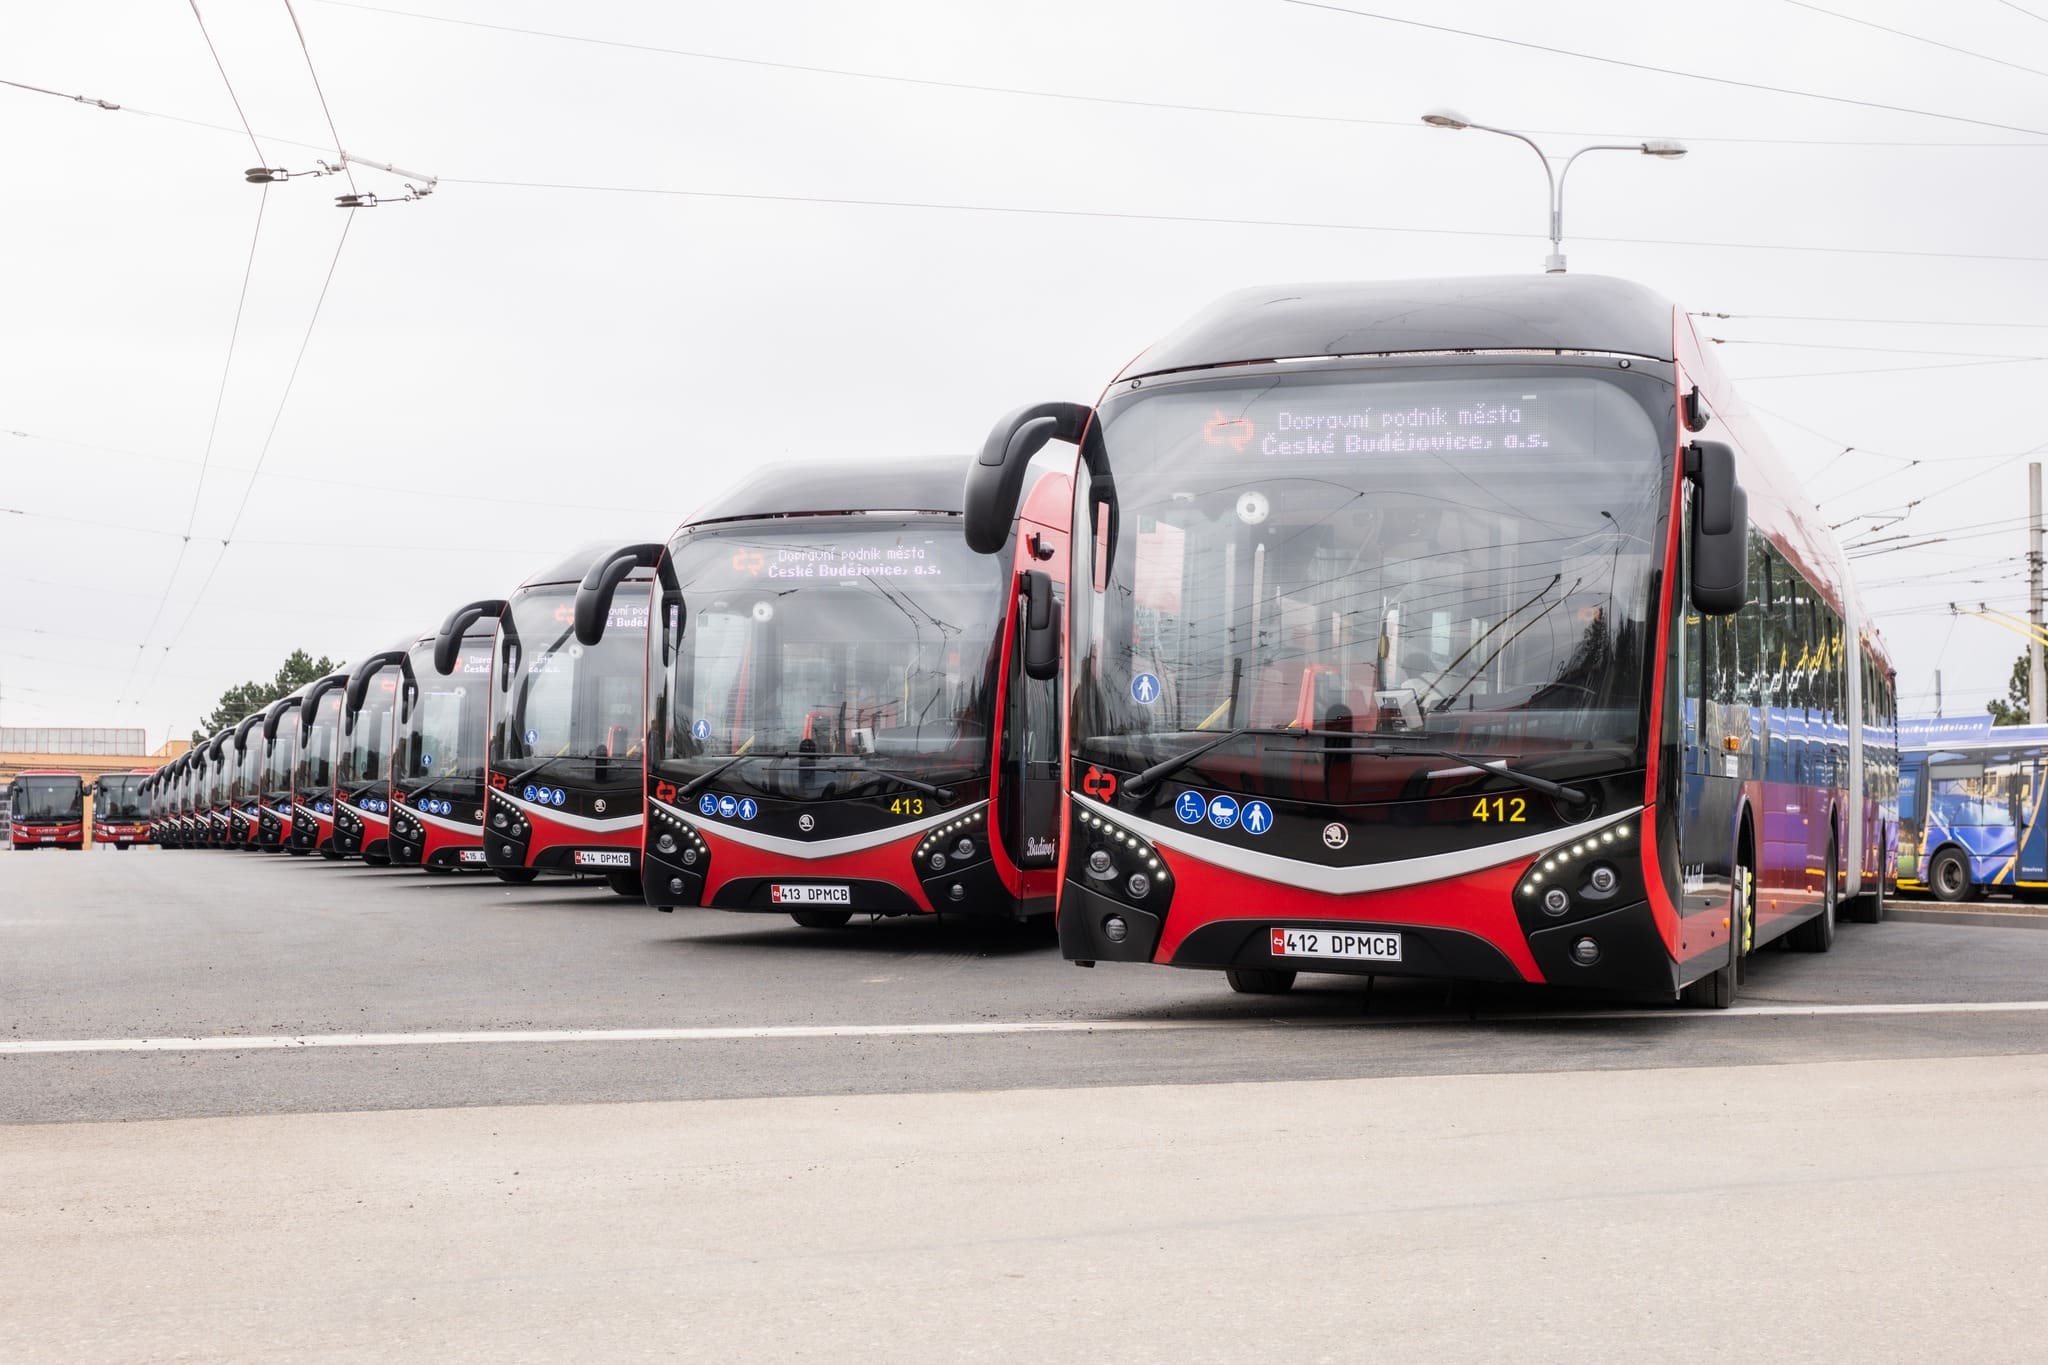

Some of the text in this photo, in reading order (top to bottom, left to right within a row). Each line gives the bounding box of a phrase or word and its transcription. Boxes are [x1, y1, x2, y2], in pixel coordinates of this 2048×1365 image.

[1278, 402, 1521, 431] Dopravní podnik města
[1262, 431, 1549, 455] České Budějovice, a.s.
[778, 544, 925, 562] Dopravní podnik města
[768, 562, 942, 578] České Budějovice, a.s.
[890, 798, 923, 814] 413
[1472, 798, 1526, 822] 412
[581, 853, 629, 863] 414 DPMCB
[781, 888, 848, 901] 413 DPMCB
[1286, 933, 1398, 956] 412 DPMCB
